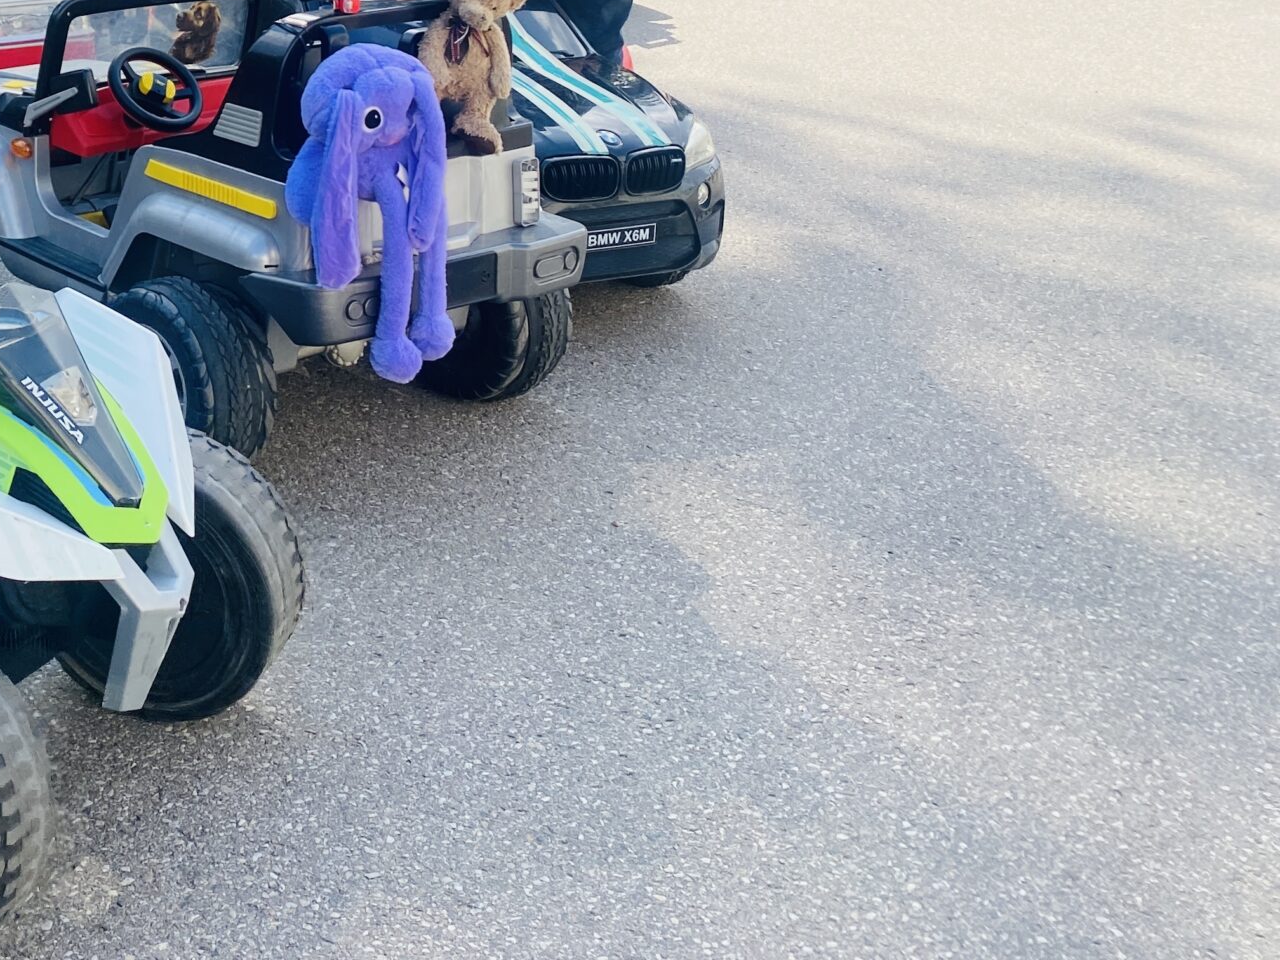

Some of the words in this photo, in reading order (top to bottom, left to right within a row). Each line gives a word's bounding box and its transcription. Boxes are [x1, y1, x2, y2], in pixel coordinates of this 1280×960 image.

[588, 232, 621, 247] BMW
[623, 228, 649, 242] X6M
[20, 376, 84, 445] INJUSA
